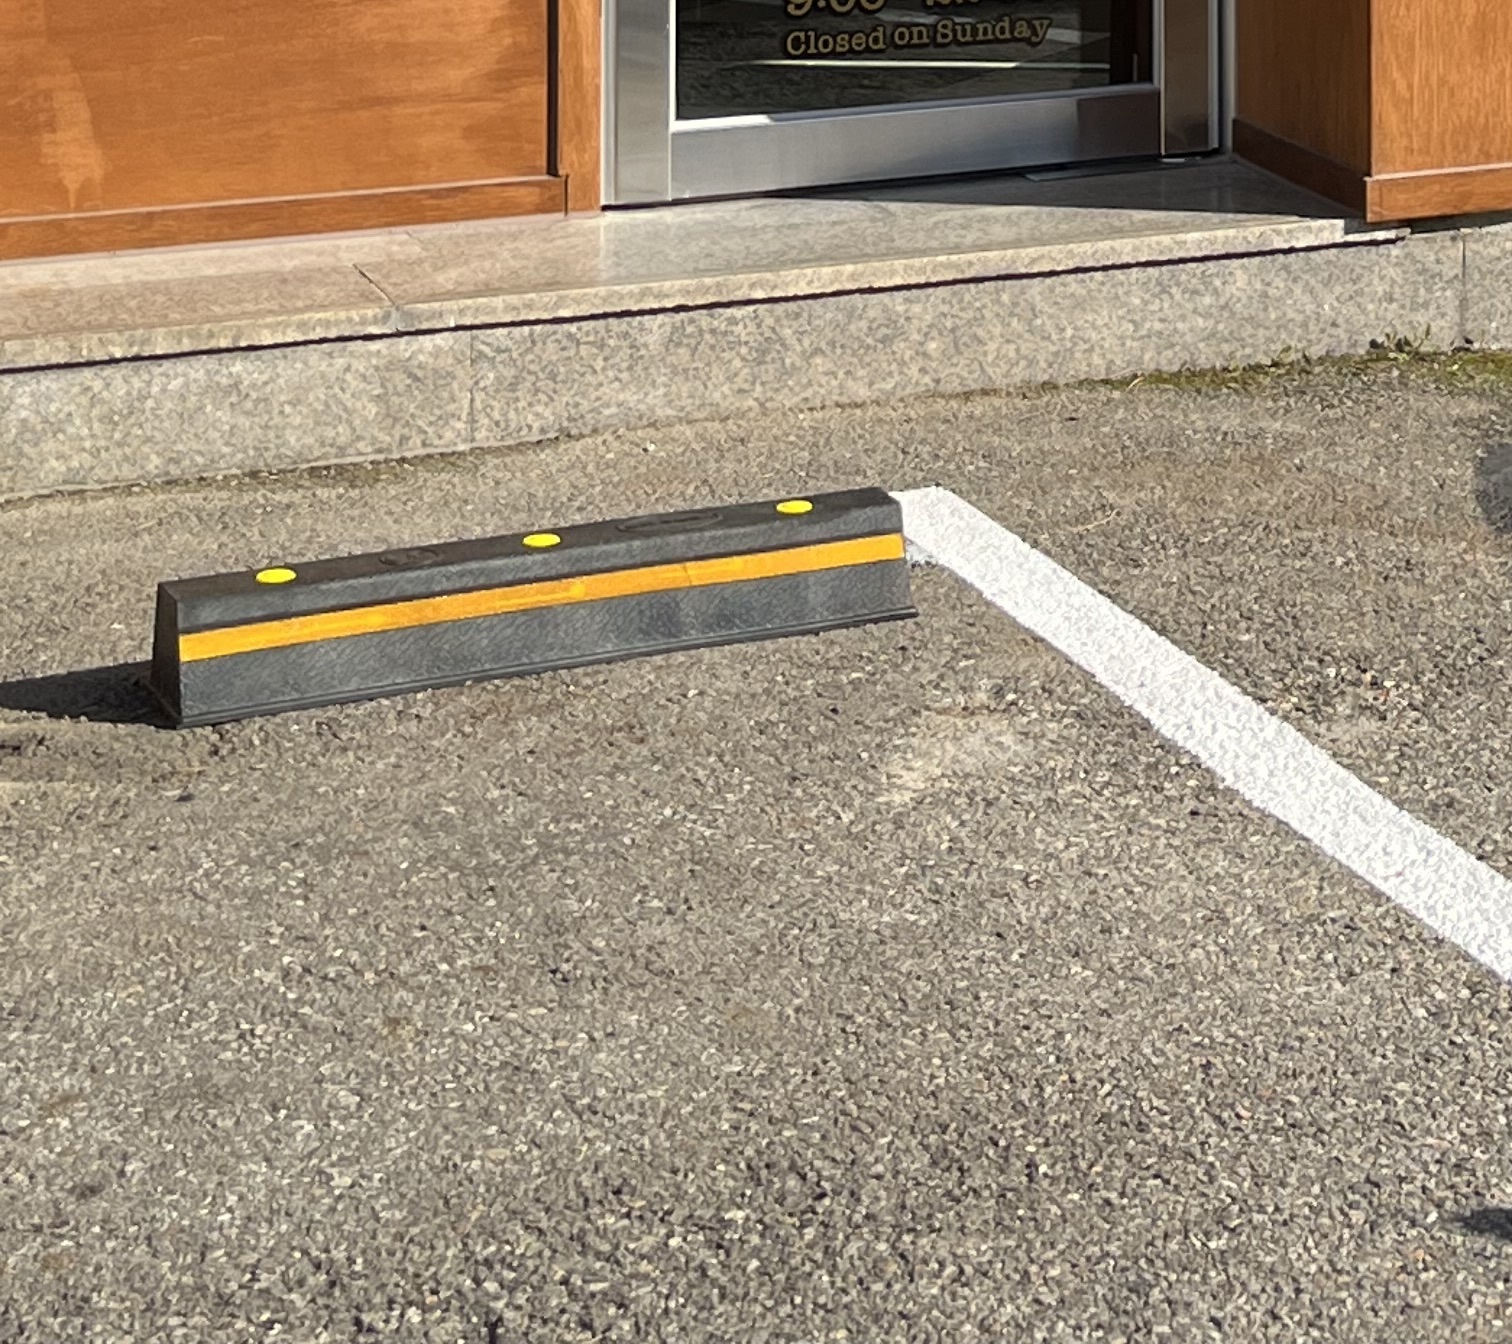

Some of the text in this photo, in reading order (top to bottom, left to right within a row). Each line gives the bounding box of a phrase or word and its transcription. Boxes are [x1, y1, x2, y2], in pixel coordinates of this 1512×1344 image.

[785, 16, 1051, 56] Closed on Sunday
